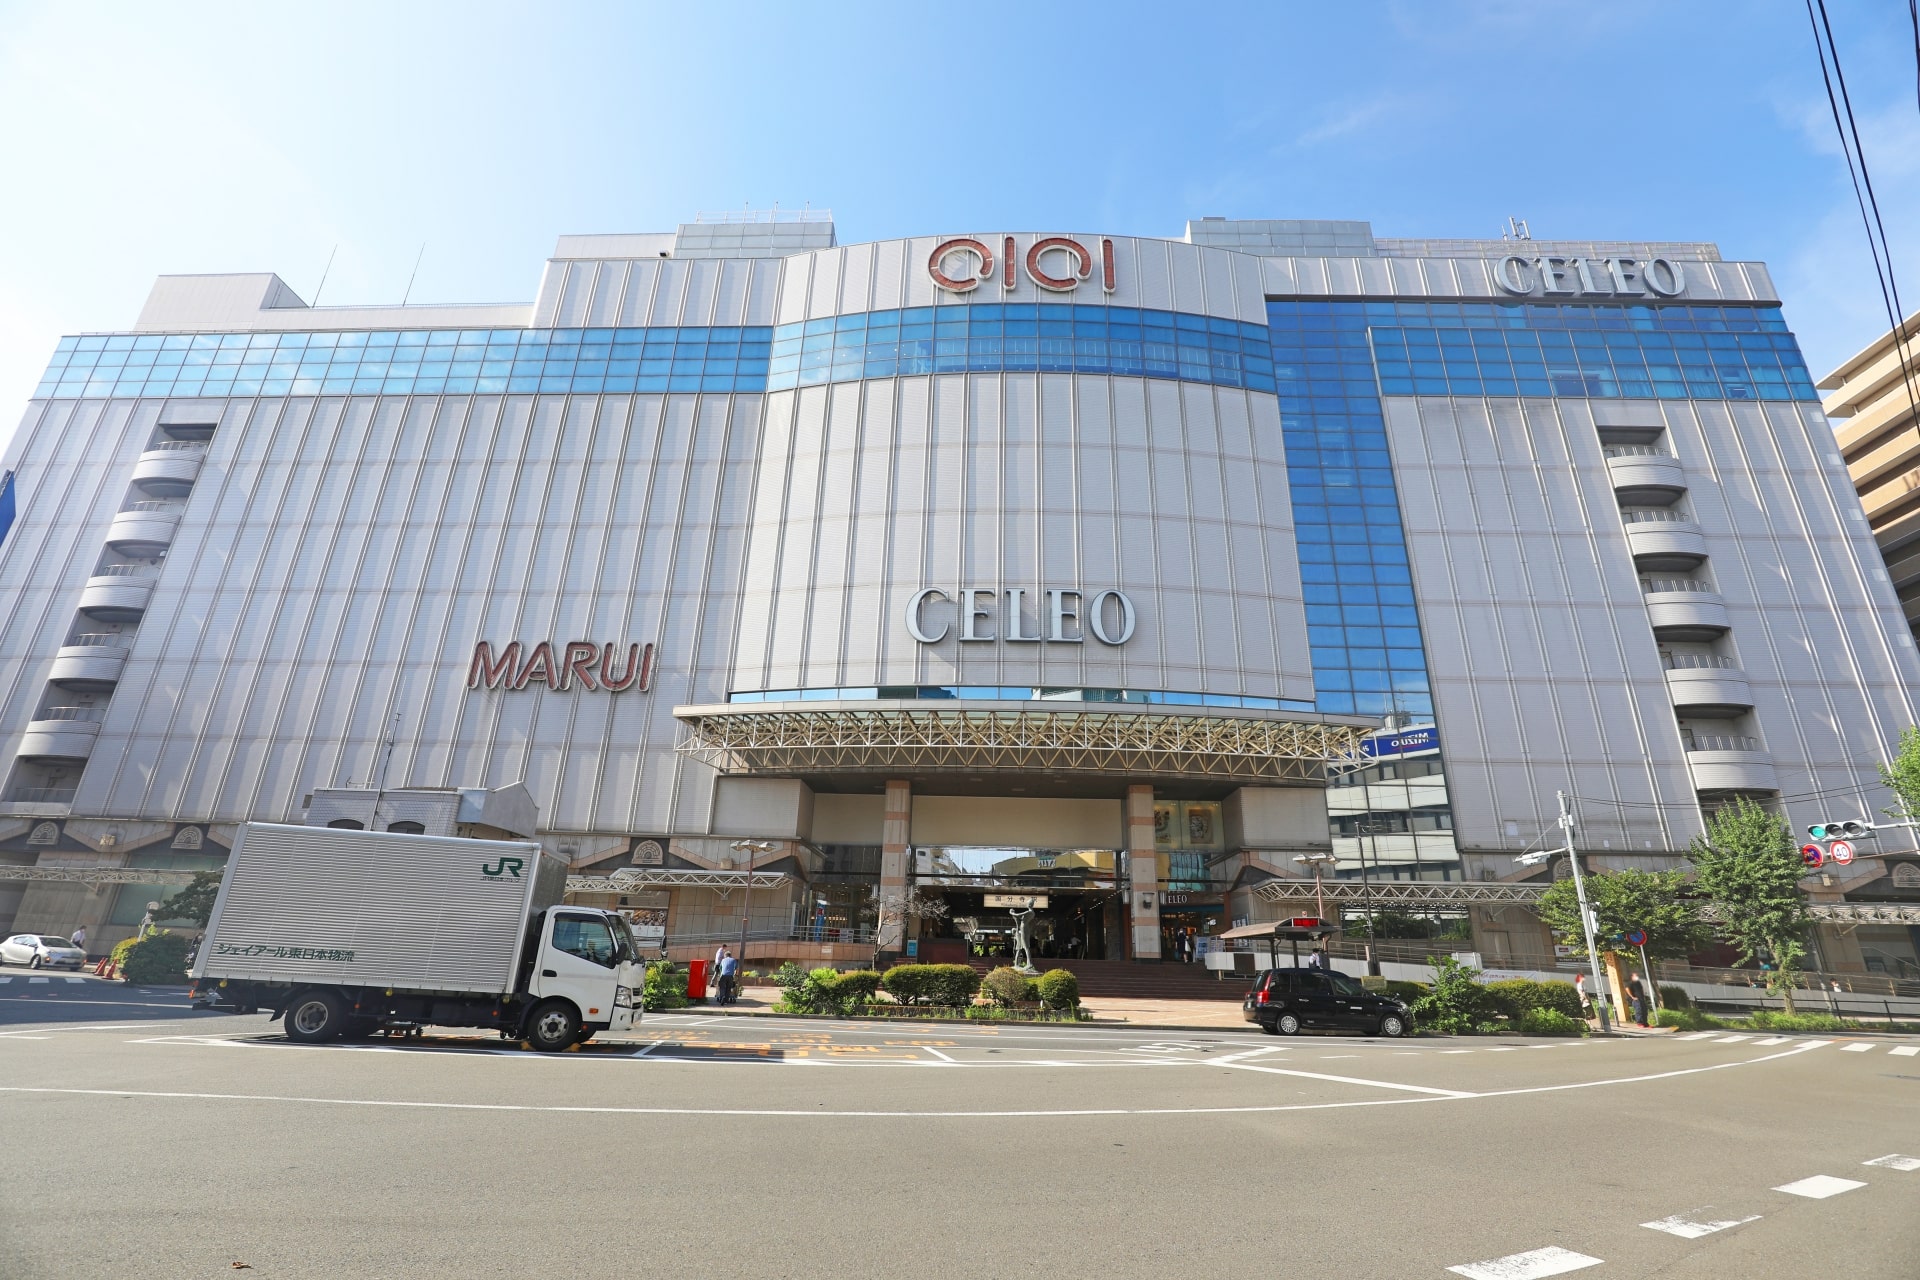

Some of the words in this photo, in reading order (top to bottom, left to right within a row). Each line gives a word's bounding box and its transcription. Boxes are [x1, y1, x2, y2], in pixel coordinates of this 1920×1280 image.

[1494, 256, 1686, 297] CELEO
[905, 587, 1136, 646] CELEO
[467, 640, 655, 691] MARUI
[483, 857, 524, 877] JR
[1836, 847, 1848, 857] 40
[217, 944, 355, 962] ジェイアール東日本物流
